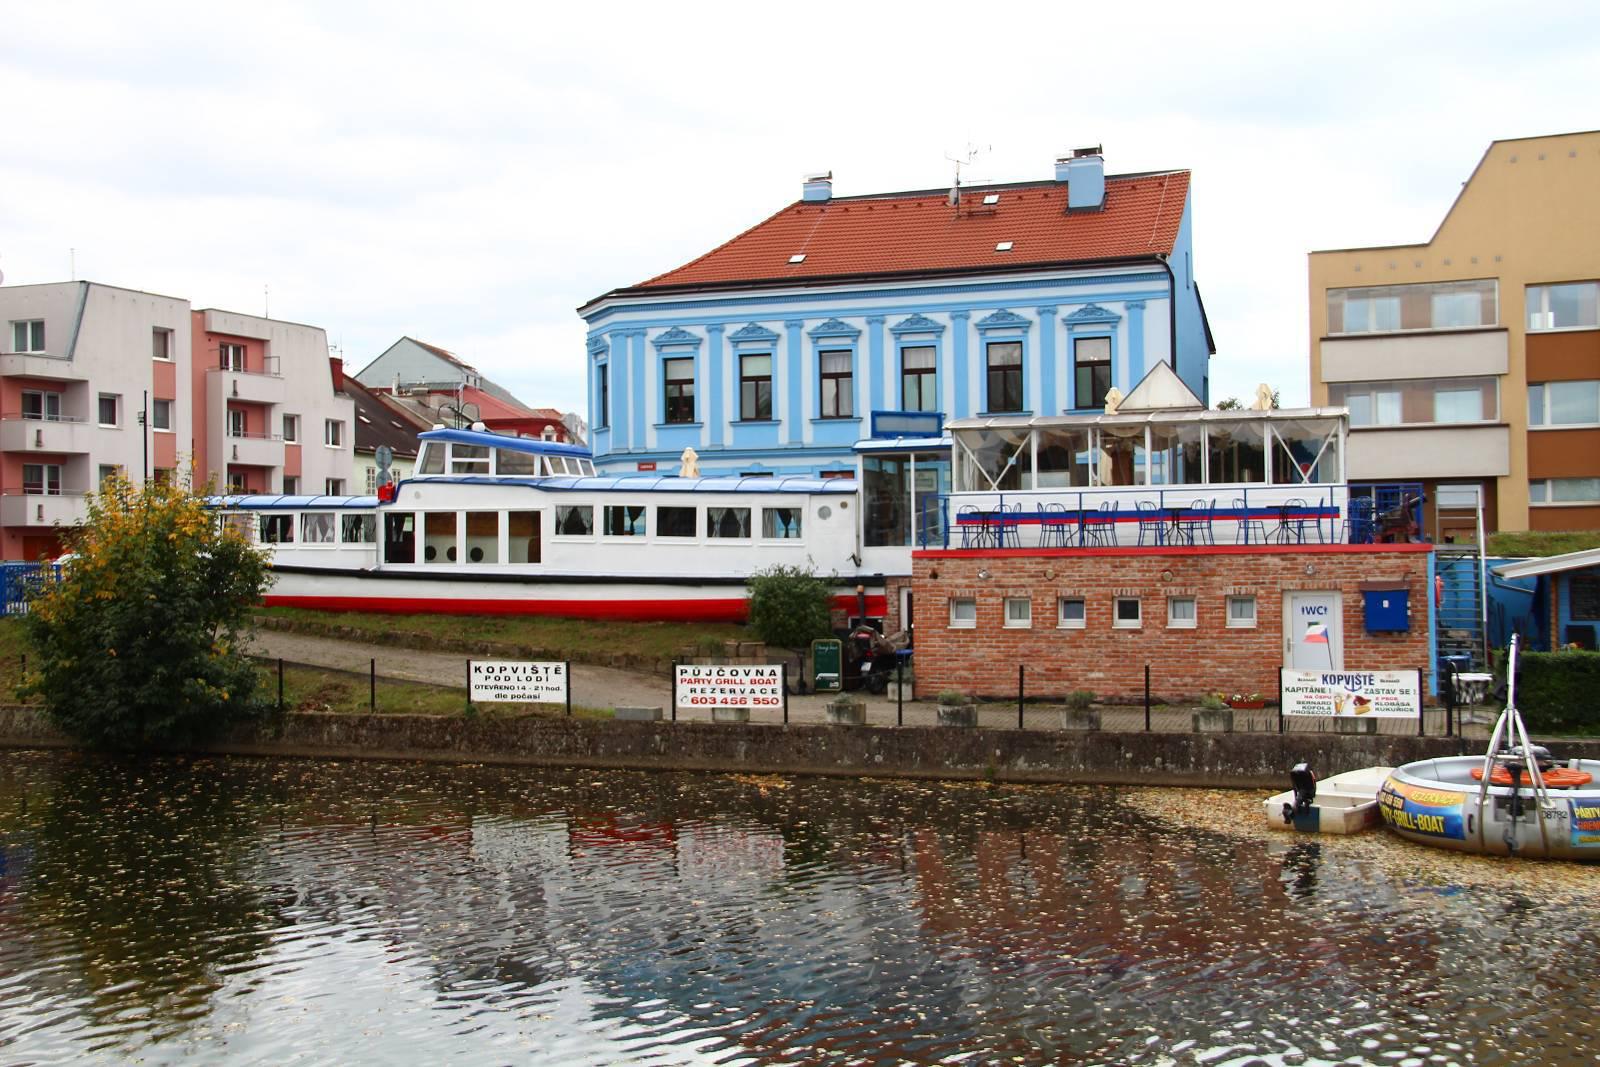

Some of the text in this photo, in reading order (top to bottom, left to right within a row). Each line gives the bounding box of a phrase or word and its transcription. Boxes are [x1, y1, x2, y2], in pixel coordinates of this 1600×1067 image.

[475, 664, 562, 674] KOPVIŠTĚ
[680, 666, 777, 677] PŮJČOVNA
[517, 674, 549, 682] LODÍ
[1322, 673, 1375, 686] KOPVIŠTĚ
[691, 697, 780, 705] 603 456 550
